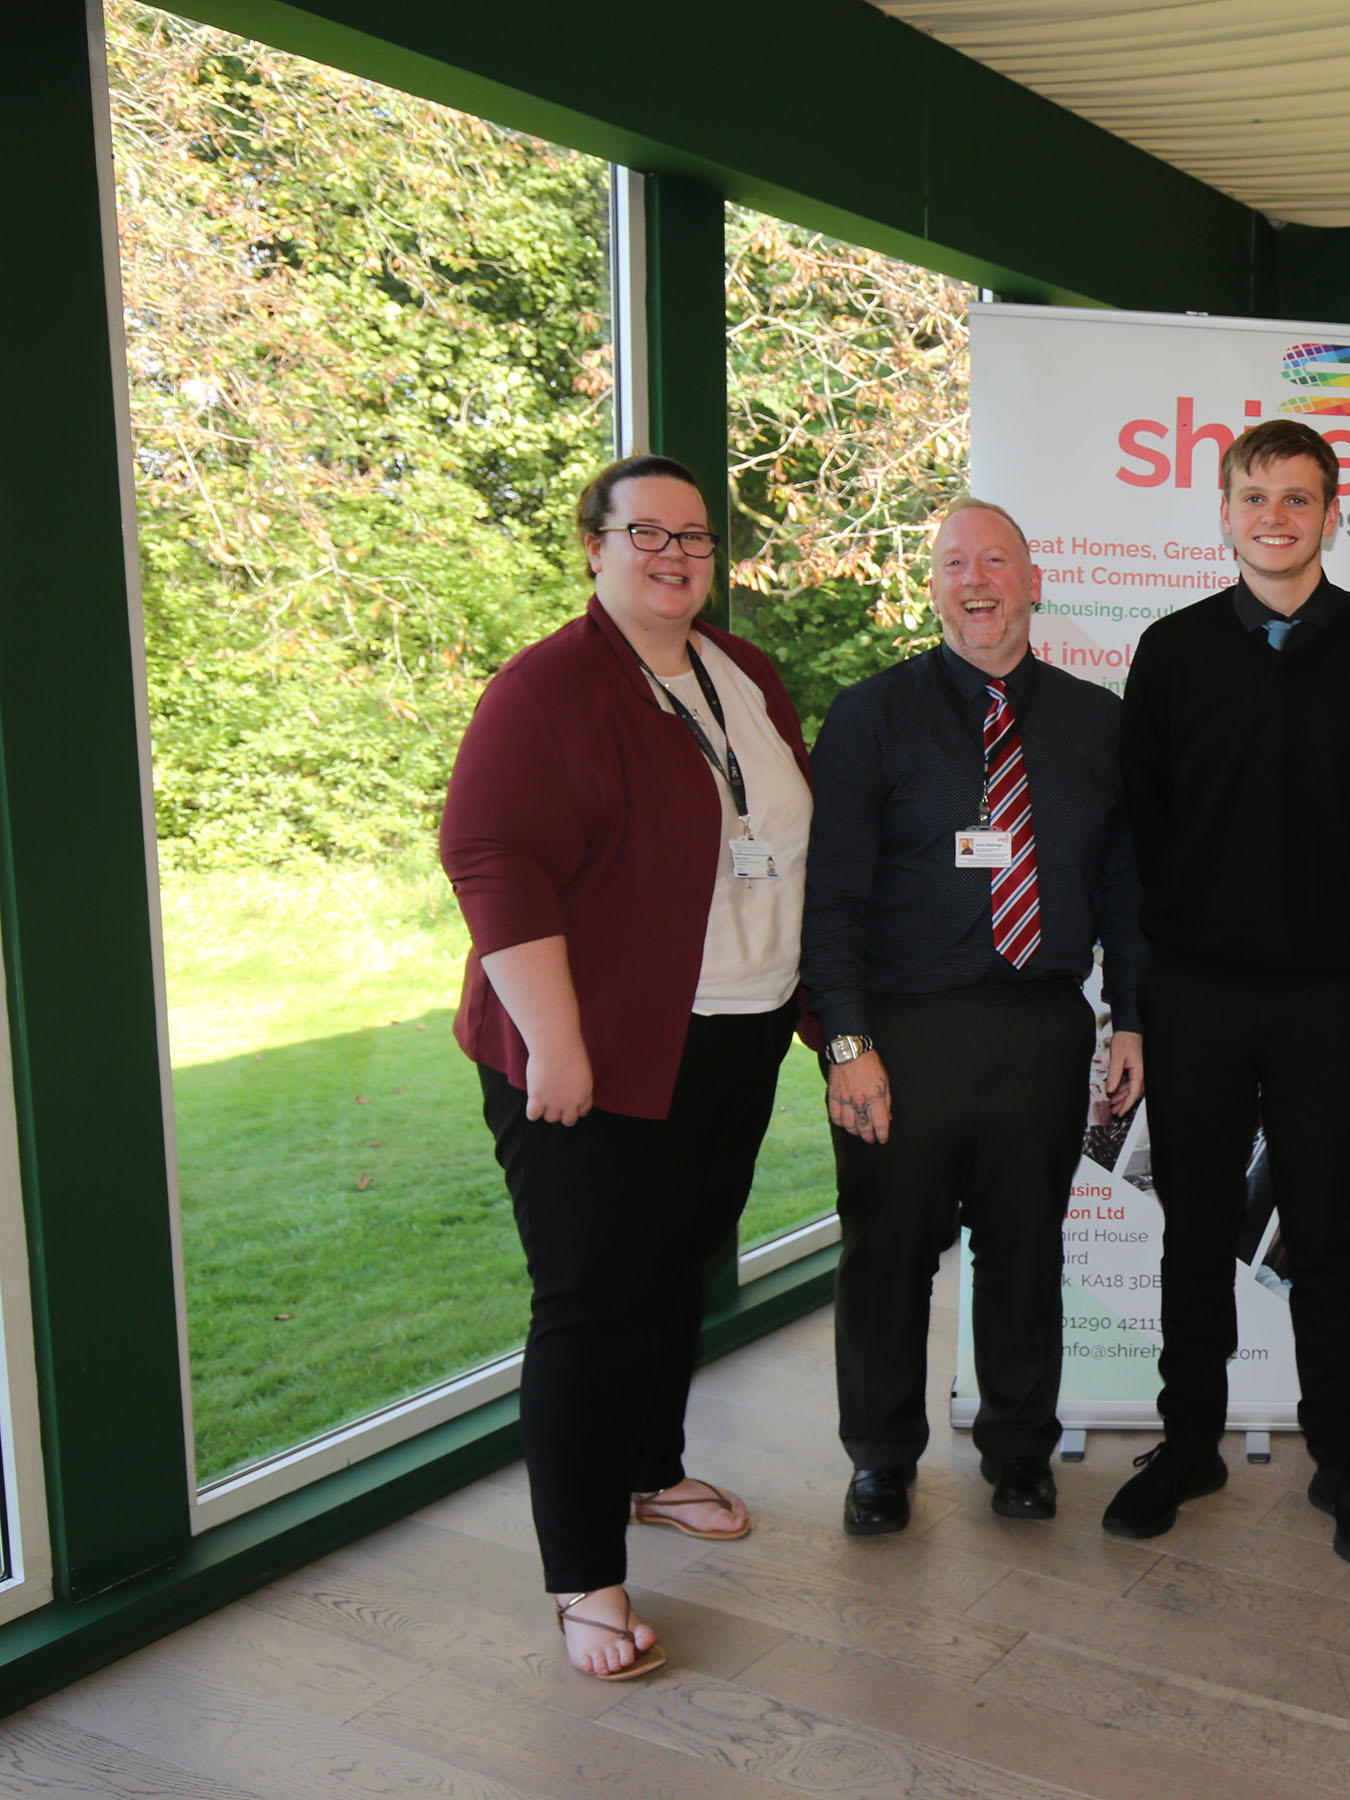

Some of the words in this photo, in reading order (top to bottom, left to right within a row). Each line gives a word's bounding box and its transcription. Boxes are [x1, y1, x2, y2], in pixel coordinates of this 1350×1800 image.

[1027, 536, 1065, 554] eat
[1072, 537, 1157, 560] Homes,
[1164, 541, 1226, 561] Great
[1040, 566, 1084, 584] rant
[1034, 600, 1181, 622] ehousing.co.u
[1062, 641, 1133, 668] invol
[1070, 1183, 1112, 1200] sing
[1065, 1207, 1091, 1220] ion
[1096, 1206, 1125, 1220] Ltd
[1062, 1229, 1089, 1242] ird
[1094, 1229, 1149, 1243] House
[1081, 1274, 1124, 1288] KA18
